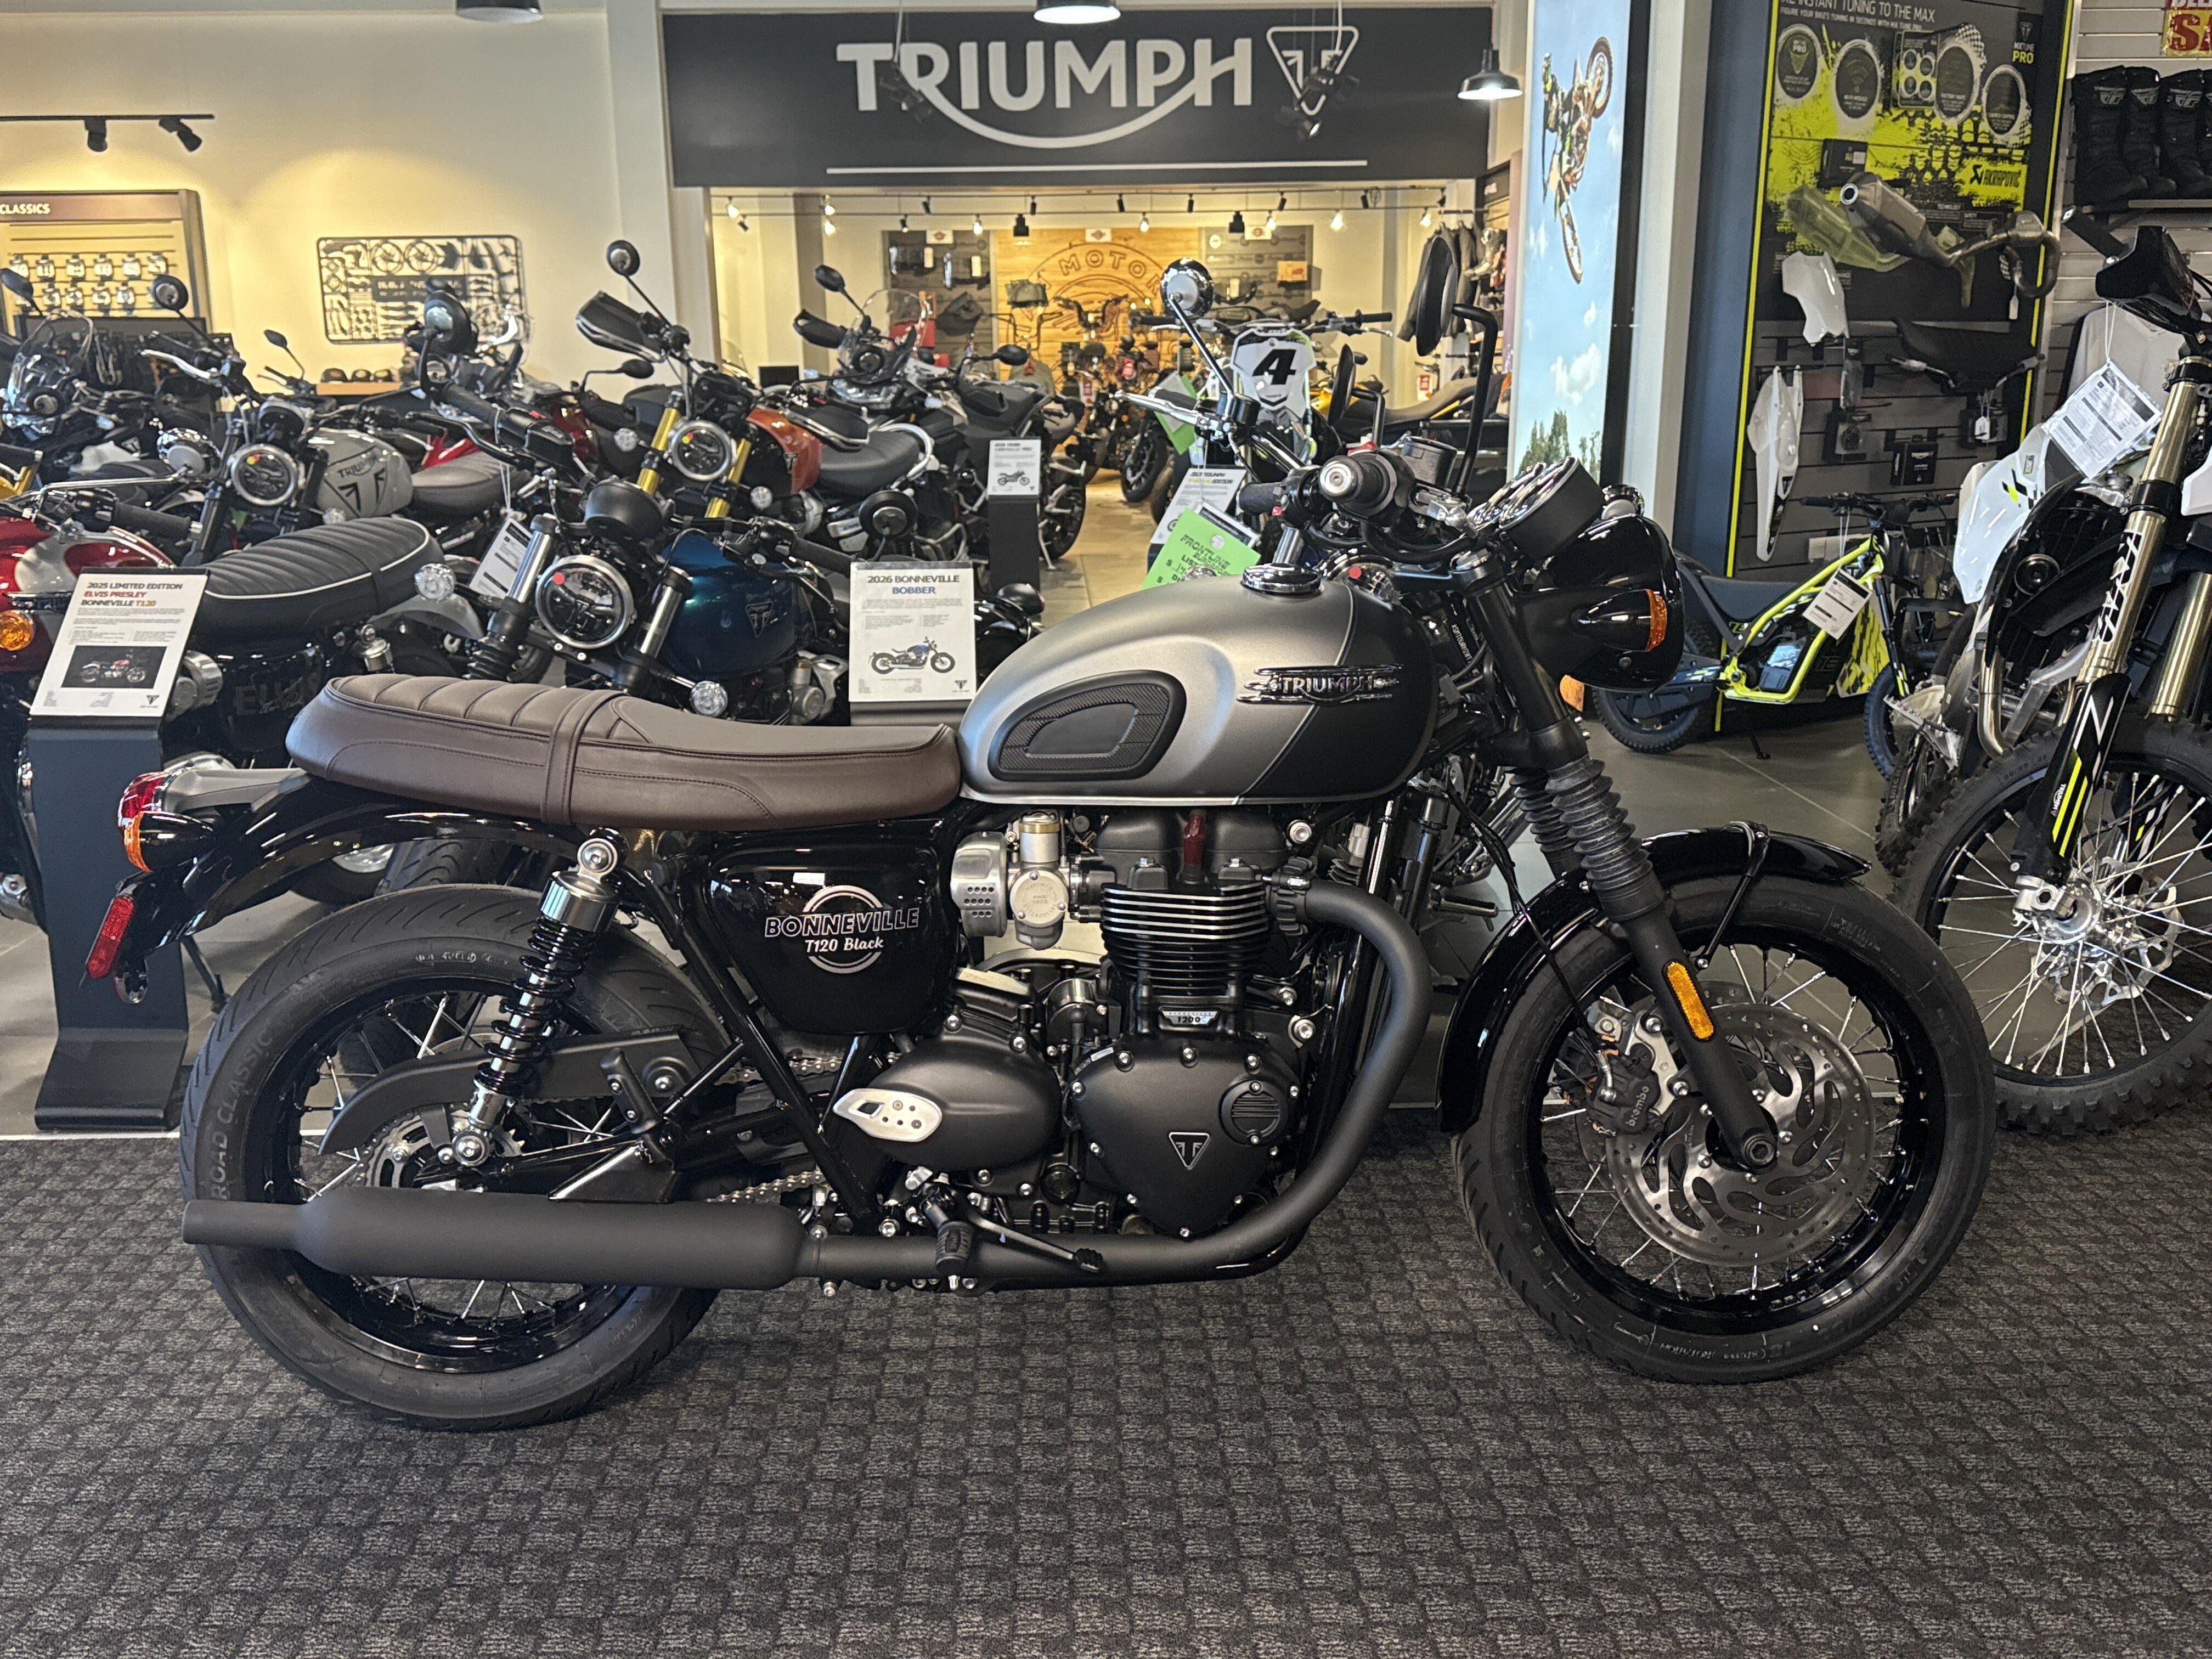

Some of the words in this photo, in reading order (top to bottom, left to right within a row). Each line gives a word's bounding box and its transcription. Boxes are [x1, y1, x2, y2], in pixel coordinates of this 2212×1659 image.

[1842, 0, 1876, 15] TUNING
[1878, 2, 1891, 17] TO
[1894, 3, 1911, 20] THE
[1914, 7, 1936, 22] MAX
[2012, 50, 2035, 64] PRO
[836, 37, 1253, 148] TRIUMPH
[0, 203, 51, 215] CLASSICS
[1251, 349, 1297, 385] 4
[1180, 534, 1231, 569] FRONTLINE
[1282, 676, 1373, 701] TRIUMPH
[2052, 783, 2067, 810] TRIUMPH
[764, 907, 920, 937] BONNEVILLE
[804, 938, 838, 953] T120
[843, 936, 884, 951] Black
[217, 1029, 273, 1125] CLASSIC
[1625, 1086, 1649, 1127] brembo
[211, 1132, 229, 1200] ROAD
